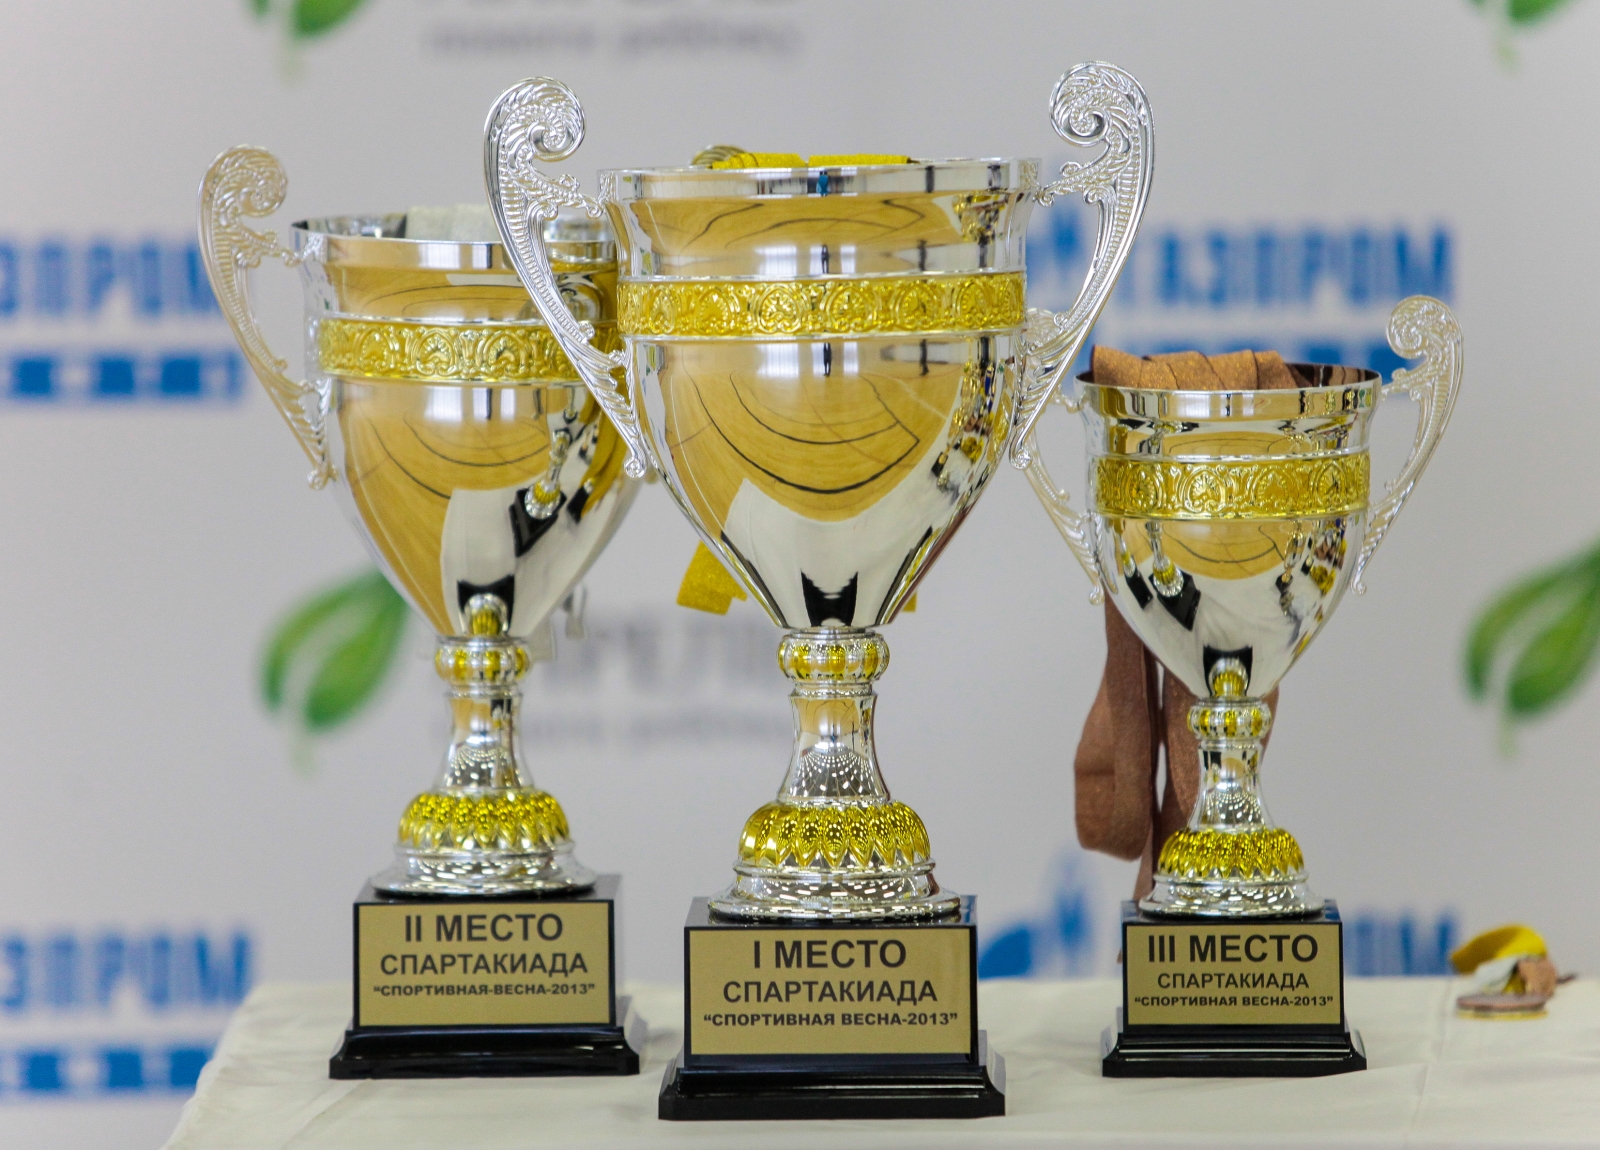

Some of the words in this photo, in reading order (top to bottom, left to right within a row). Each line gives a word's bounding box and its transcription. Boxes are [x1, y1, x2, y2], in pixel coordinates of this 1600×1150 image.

[404, 914, 423, 943] II
[434, 912, 564, 943] МЕСТО
[753, 939, 761, 969] I
[774, 938, 907, 969] МЕСТО
[1148, 934, 1176, 963] III
[1189, 933, 1319, 963] МЕСТО
[380, 952, 589, 978] СПАРТАКИАДА
[723, 979, 938, 1006] СПАРТАКИАДА
[1157, 972, 1310, 992] СПАРТАКИАДА
